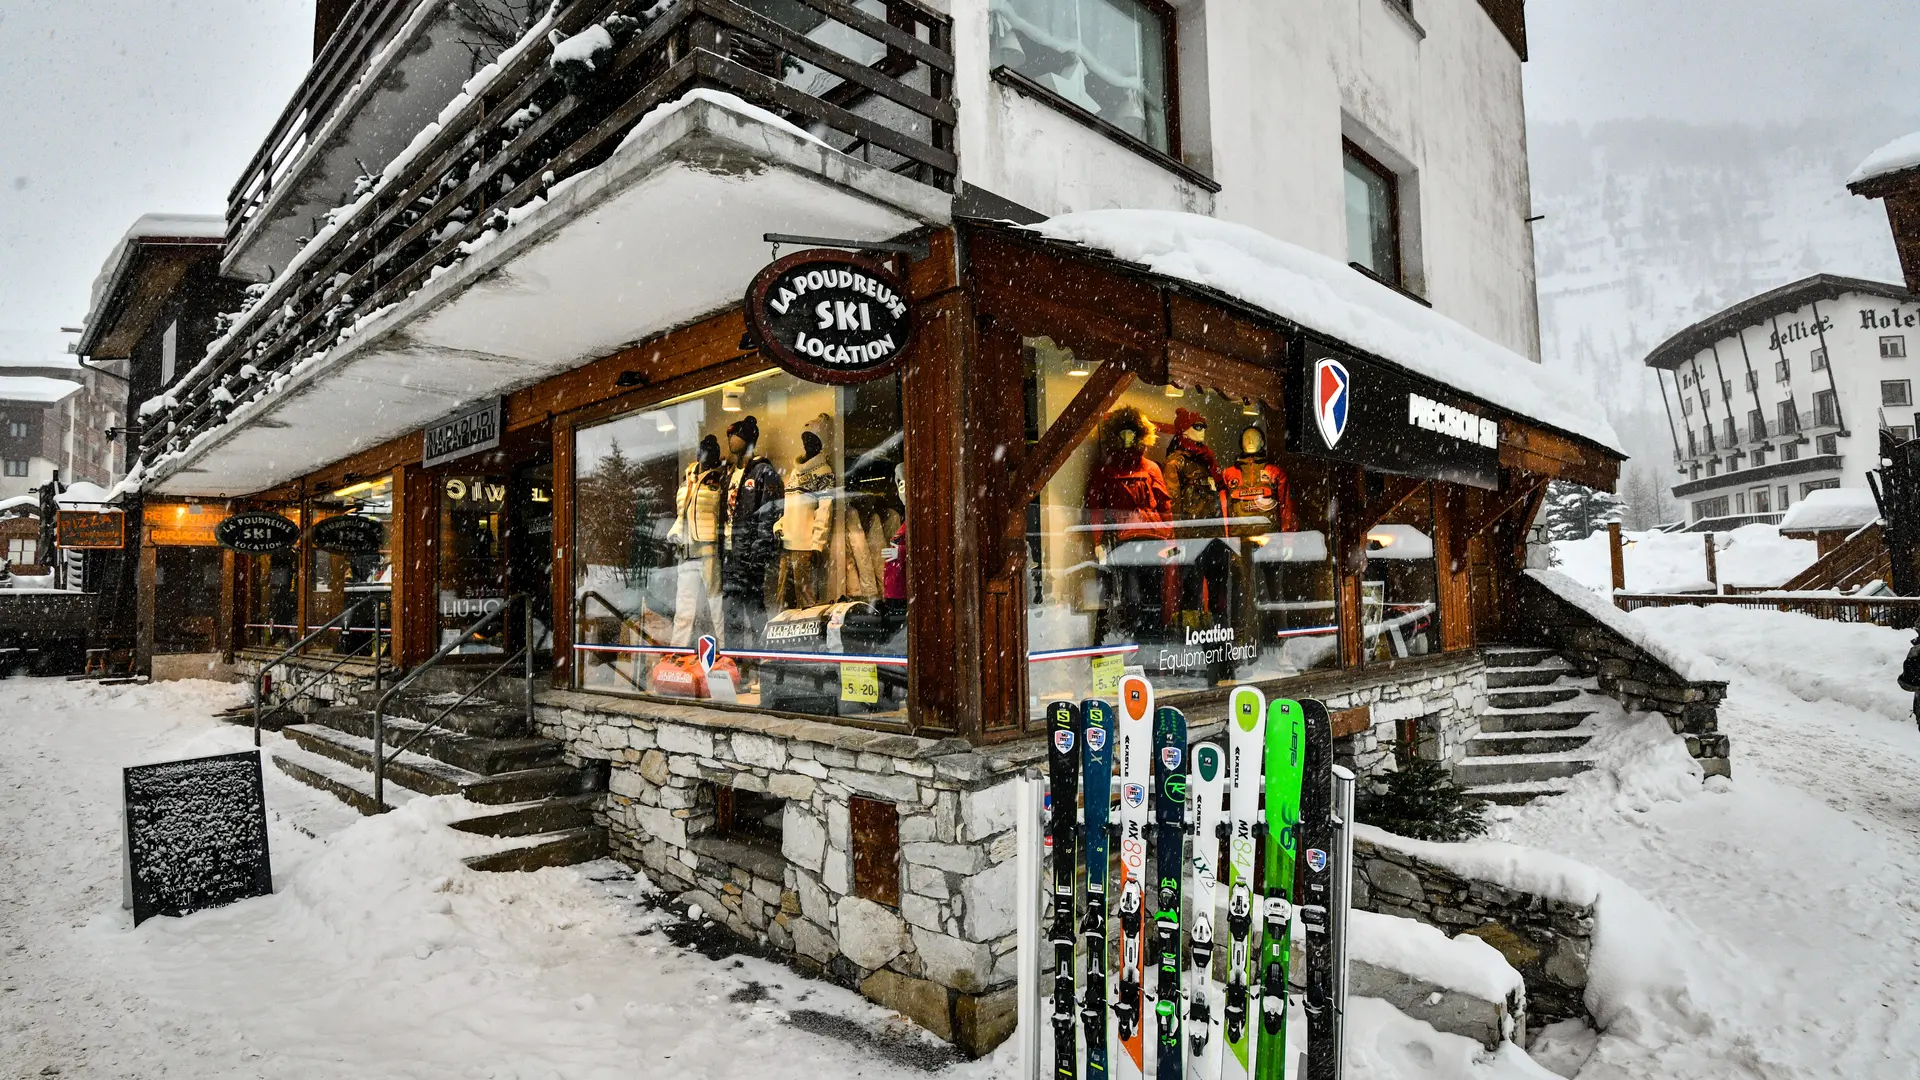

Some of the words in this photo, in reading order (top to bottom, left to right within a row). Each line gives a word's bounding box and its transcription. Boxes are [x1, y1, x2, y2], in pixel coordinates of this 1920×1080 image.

[769, 286, 797, 315] LA
[792, 269, 907, 320] POUDREUSE
[815, 300, 872, 331] SKI
[794, 331, 896, 364] LOCATION
[1409, 392, 1479, 444] PRECISION
[1479, 418, 1498, 449] SKI
[60, 515, 112, 532] PIZZA
[222, 521, 236, 533] LA
[238, 516, 292, 534] POUDREUSE
[243, 528, 272, 539] SKI
[234, 541, 283, 551] LOCATION
[1185, 623, 1235, 646] Location
[1159, 648, 1224, 674] Equipment
[1225, 640, 1257, 662] Rental
[1289, 721, 1298, 768] elan
